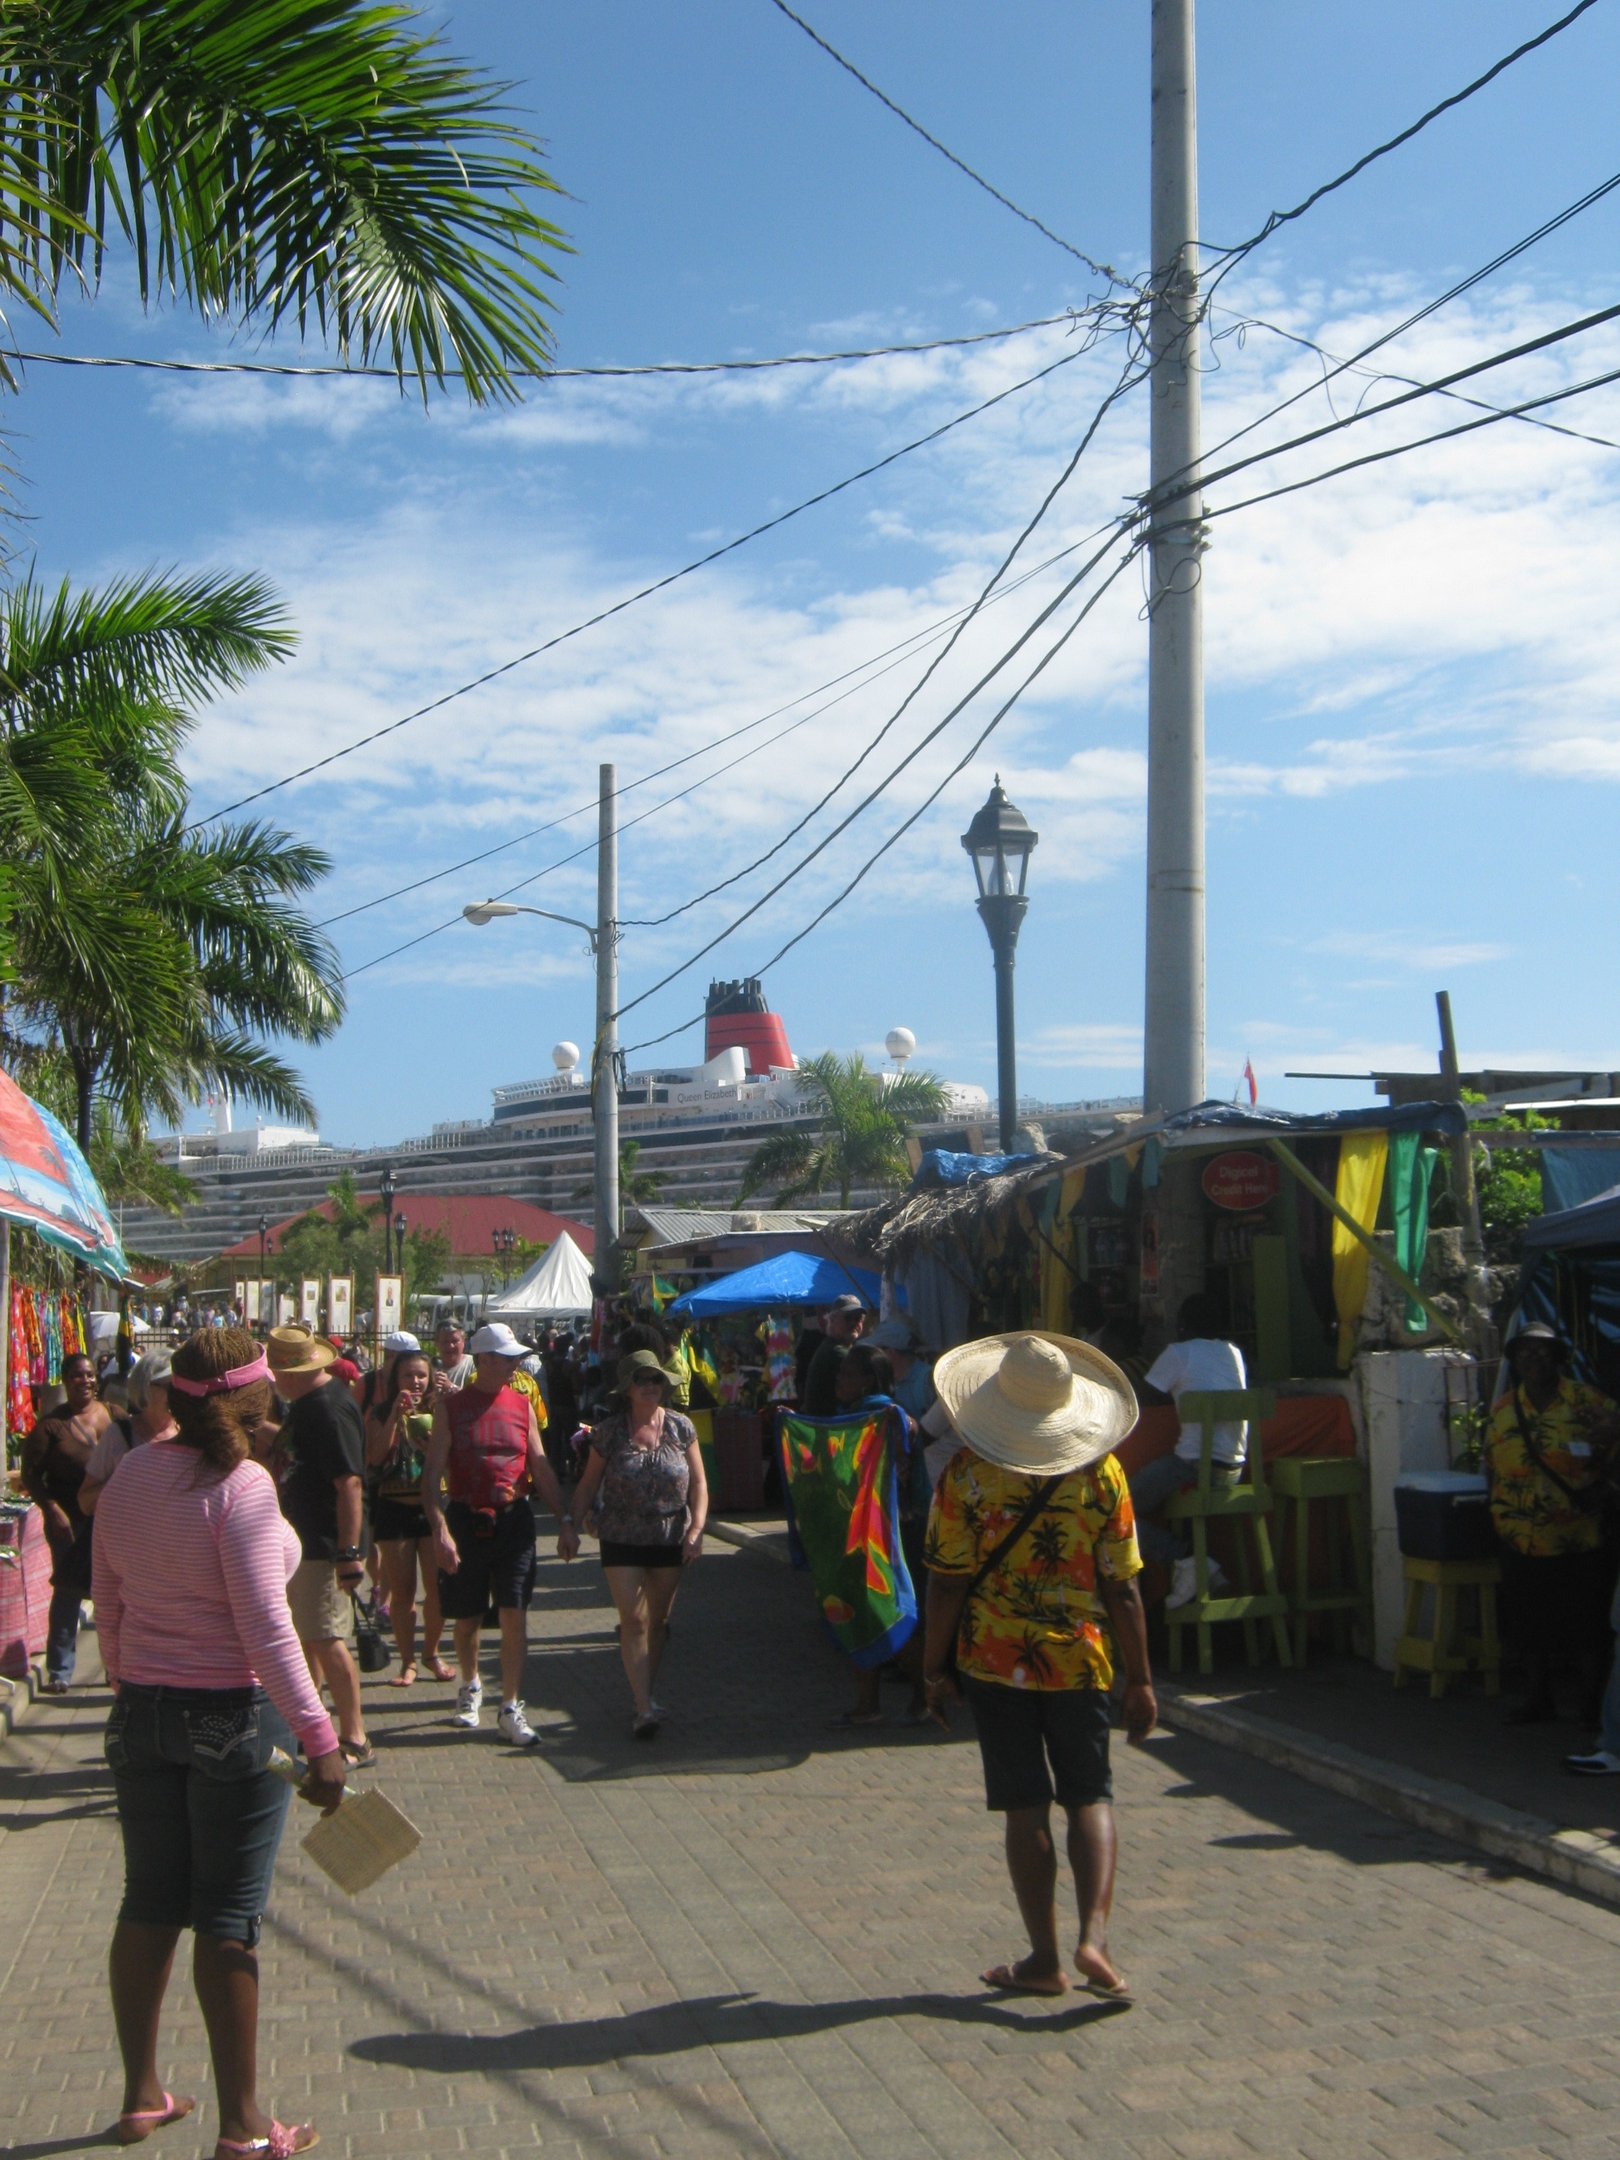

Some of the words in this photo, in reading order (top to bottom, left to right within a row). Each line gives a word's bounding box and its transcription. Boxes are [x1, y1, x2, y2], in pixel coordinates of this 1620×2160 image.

[677, 1093, 702, 1103] Queen
[704, 1088, 737, 1100] Elizabeth
[1219, 1165, 1258, 1181] Digicel
[1211, 1184, 1242, 1196] Credit
